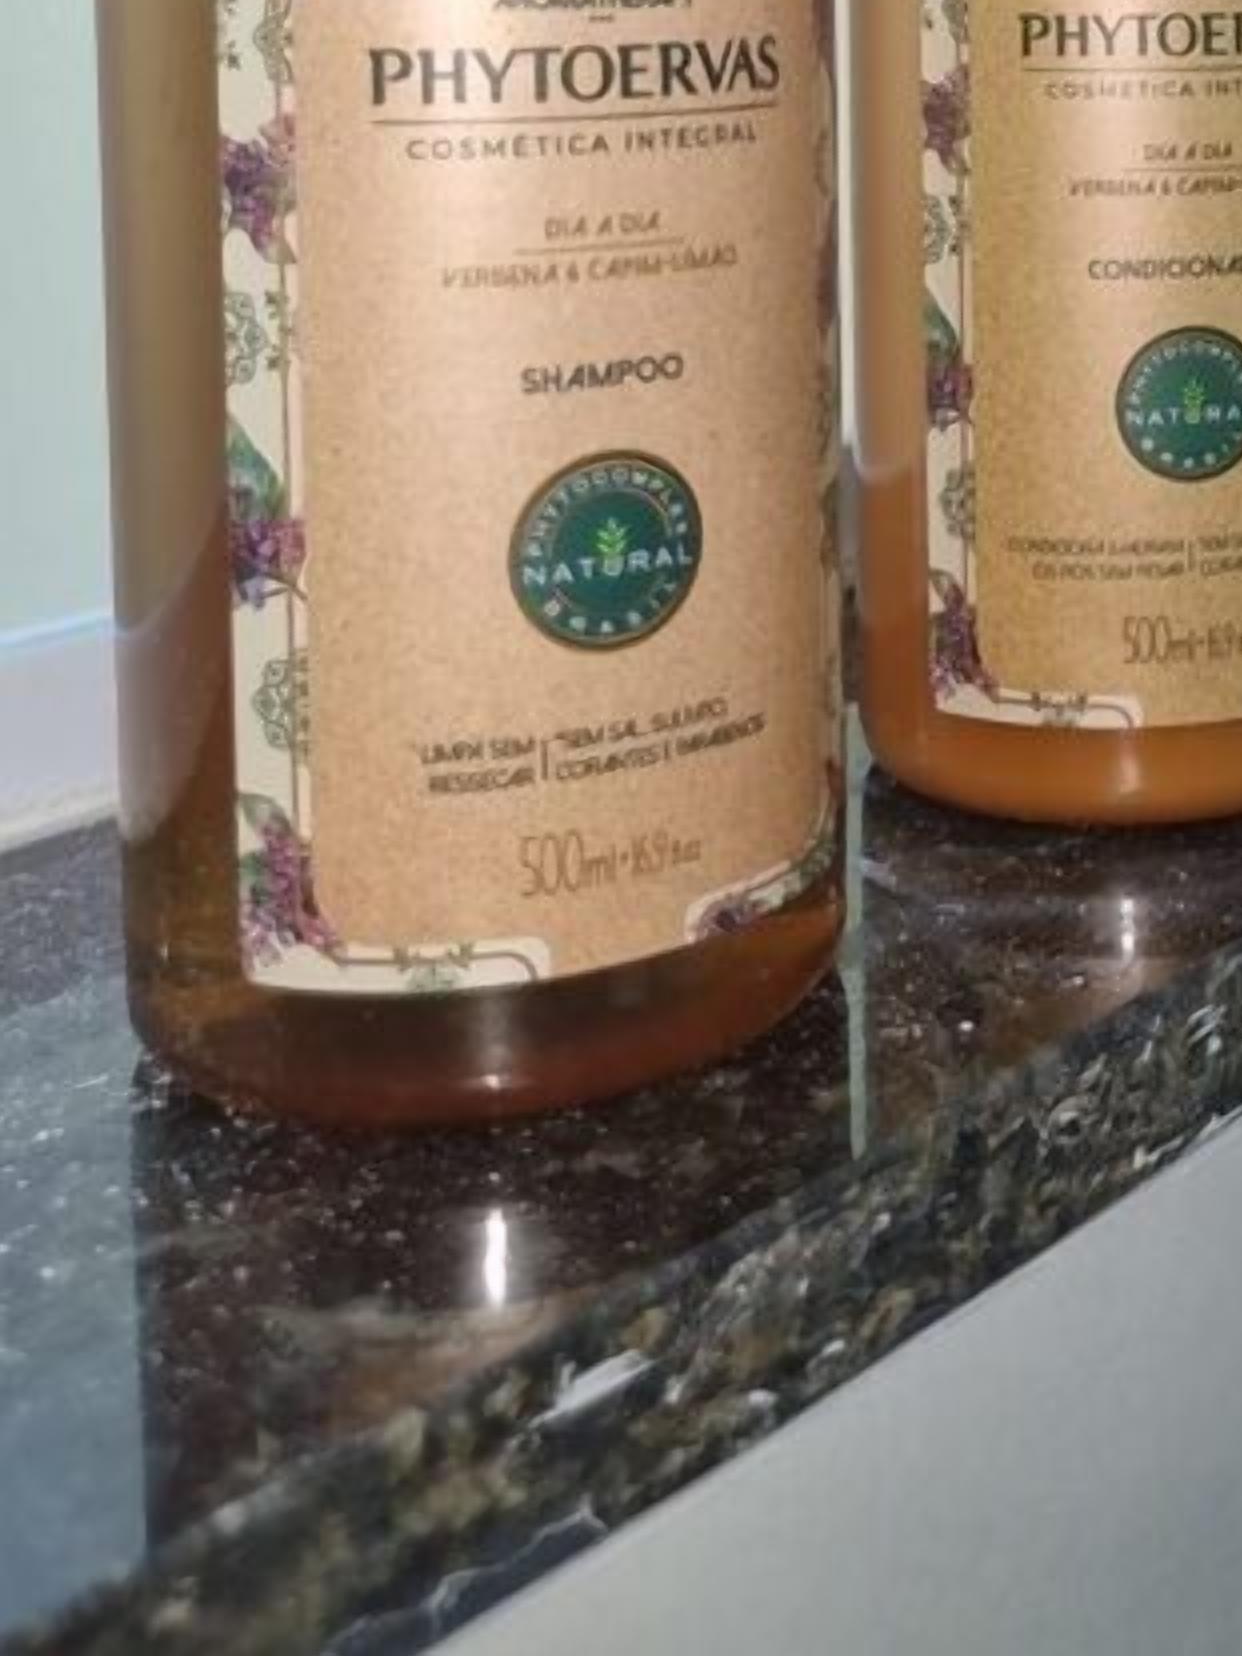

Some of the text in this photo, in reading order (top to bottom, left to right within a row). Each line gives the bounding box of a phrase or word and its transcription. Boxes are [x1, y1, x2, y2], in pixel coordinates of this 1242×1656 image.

[369, 34, 780, 106] PHYTOERVAS
[623, 122, 757, 154] INTEGRAL
[544, 210, 660, 241] DIA A DIA
[520, 351, 684, 395] SHAMPOO
[521, 543, 694, 586] NATURAL
